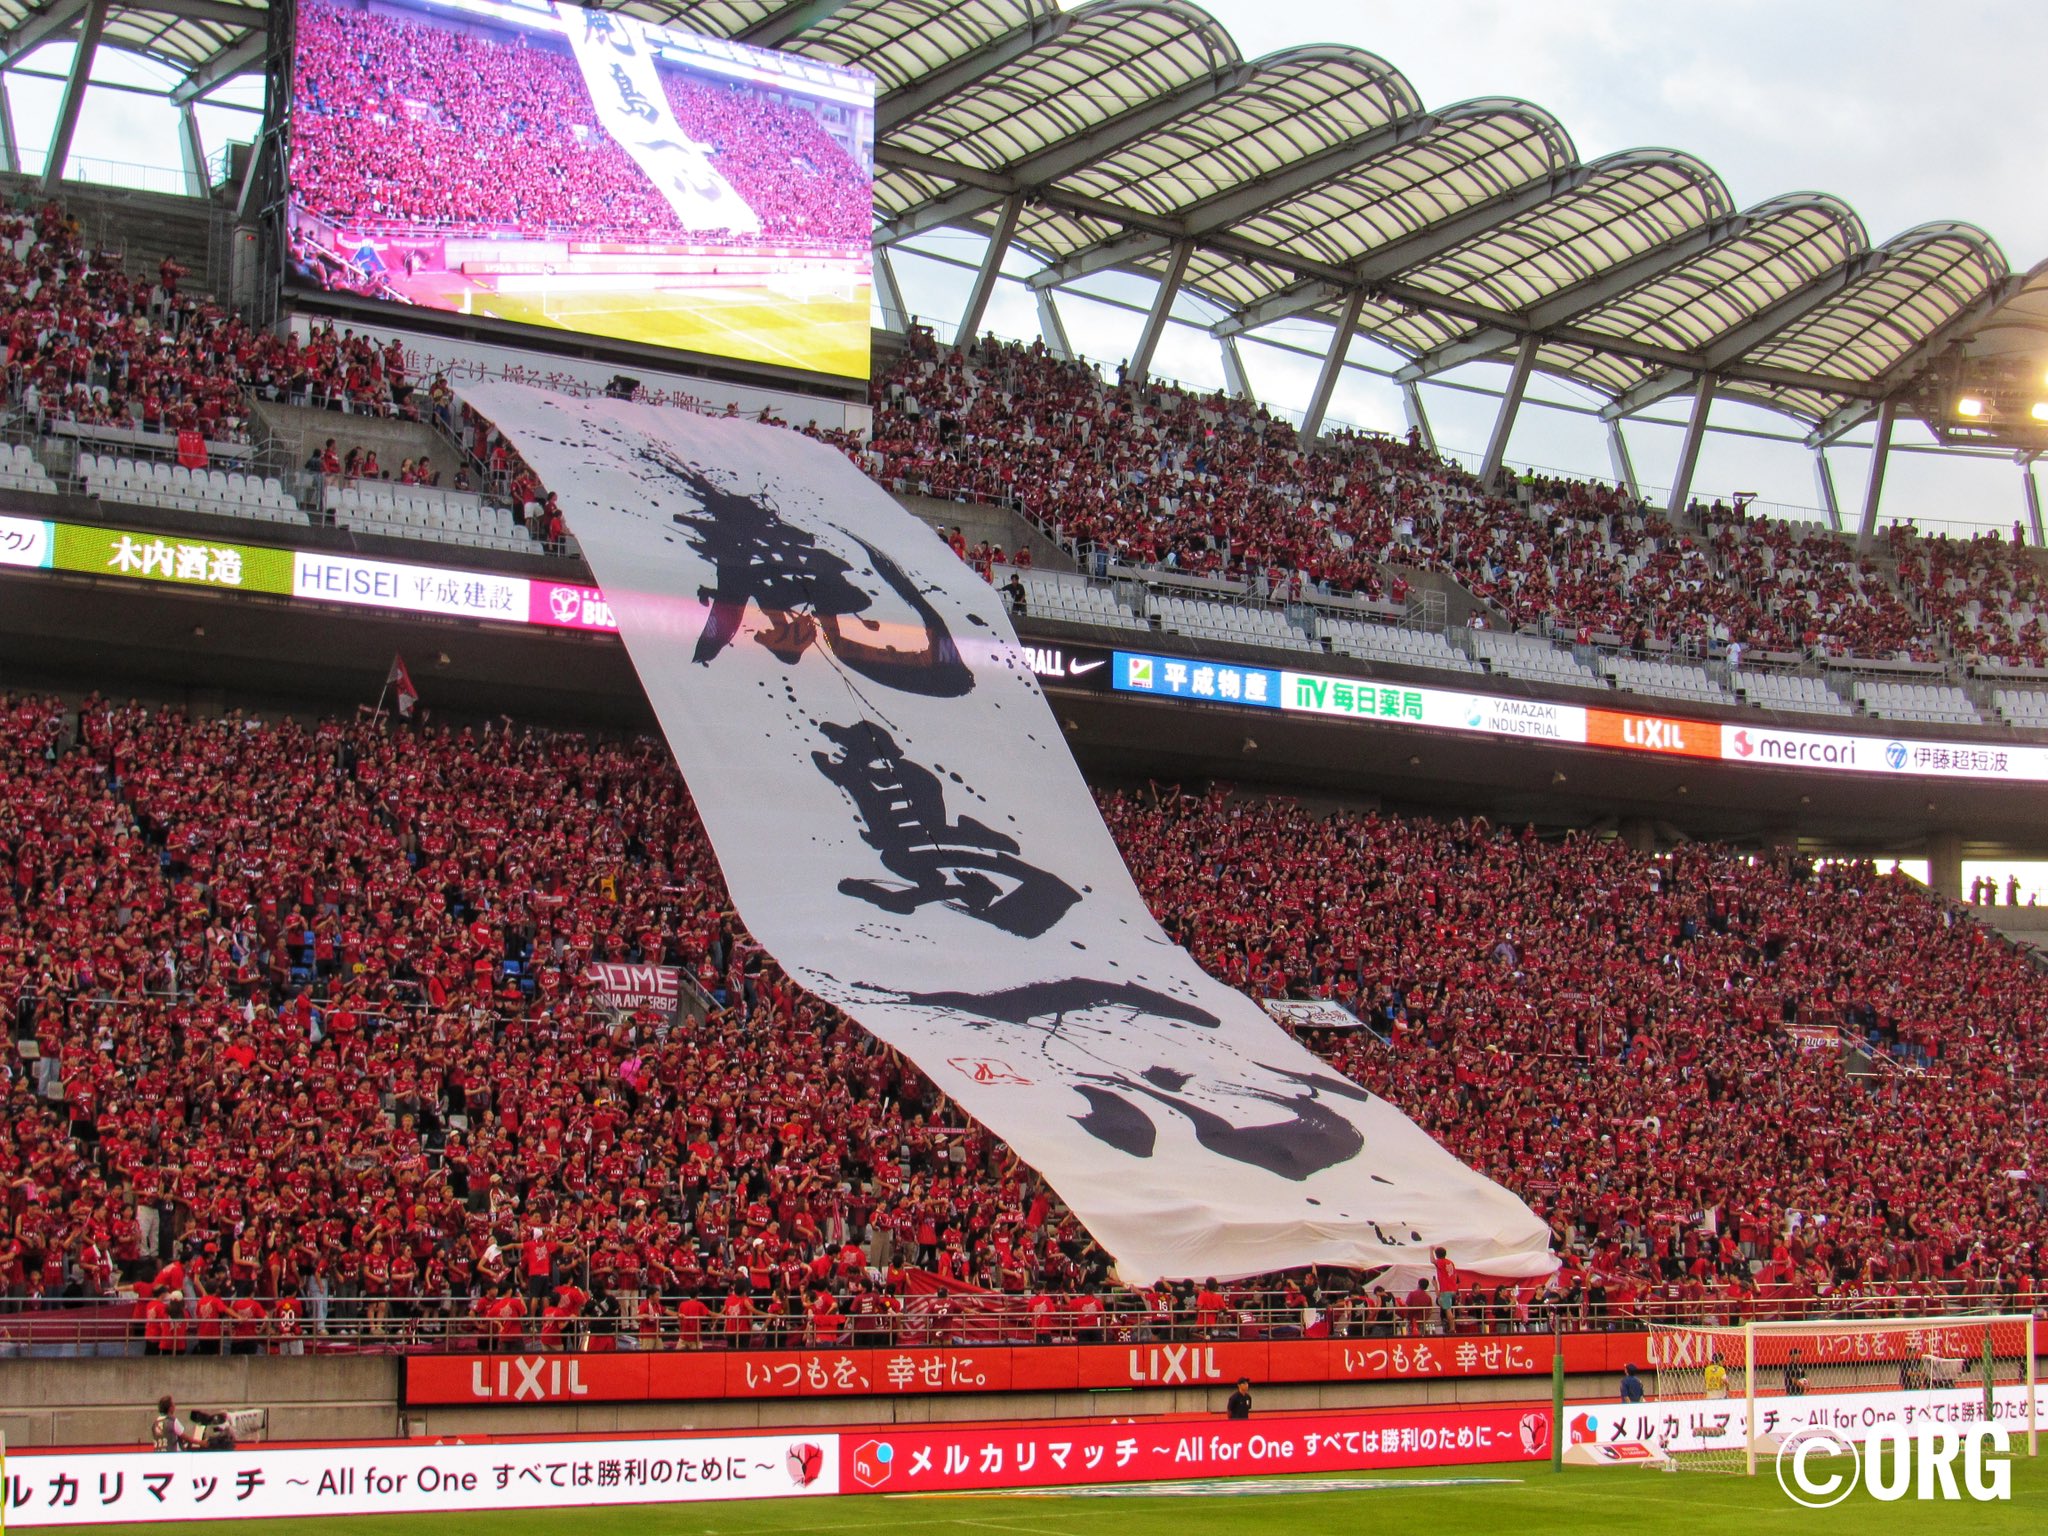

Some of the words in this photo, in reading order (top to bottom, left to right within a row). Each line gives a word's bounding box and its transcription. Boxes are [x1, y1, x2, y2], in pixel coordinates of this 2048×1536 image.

[0, 530, 36, 551] クノ
[107, 536, 243, 585] 木内酒造
[302, 563, 398, 598] HEISEI
[412, 576, 513, 611] 平成建設
[1021, 647, 1065, 676] BALL
[1165, 663, 1267, 702] 平成物産
[1332, 682, 1424, 720] 毎日薬局
[1492, 700, 1557, 720] YAMAZAKI
[1488, 717, 1561, 738] INDUSTRIAL
[1623, 719, 1685, 749] LIXIL
[1760, 740, 1856, 764] mercari
[1914, 747, 2008, 772] 伊藤超短波
[586, 965, 678, 995] HOME
[472, 1355, 588, 1400] LIXIL
[1129, 1345, 1221, 1384] LIXIL
[1833, 1407, 1857, 1428] for
[1862, 1406, 1897, 1427] One
[907, 1436, 1139, 1477] メルカリマッチ
[1209, 1435, 1243, 1461] for
[1248, 1434, 1294, 1459] One
[364, 1465, 409, 1494] for
[417, 1466, 478, 1492] One
